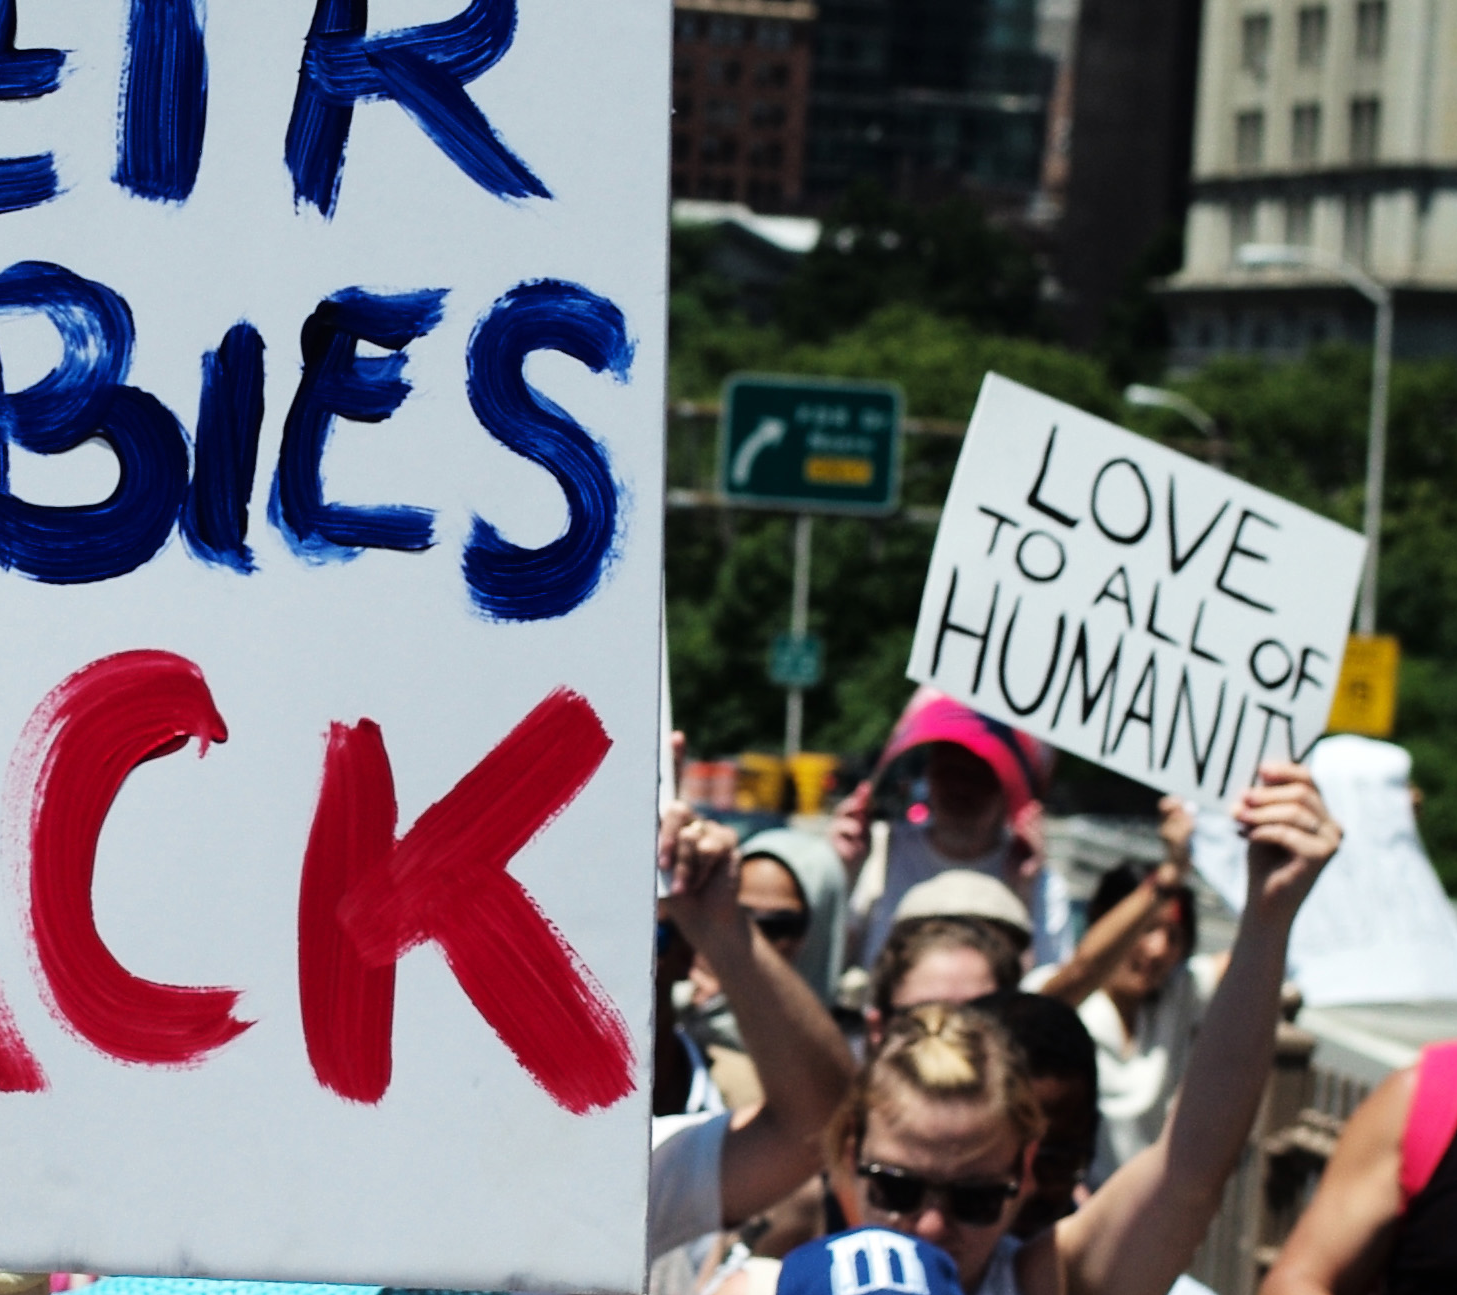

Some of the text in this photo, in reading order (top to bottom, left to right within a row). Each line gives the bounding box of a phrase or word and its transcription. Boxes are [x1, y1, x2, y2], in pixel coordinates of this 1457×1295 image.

[977, 504, 1067, 583] TO
[1092, 564, 1227, 666] ALL
[1248, 636, 1331, 701] OF
[1027, 423, 1281, 614] LOVE
